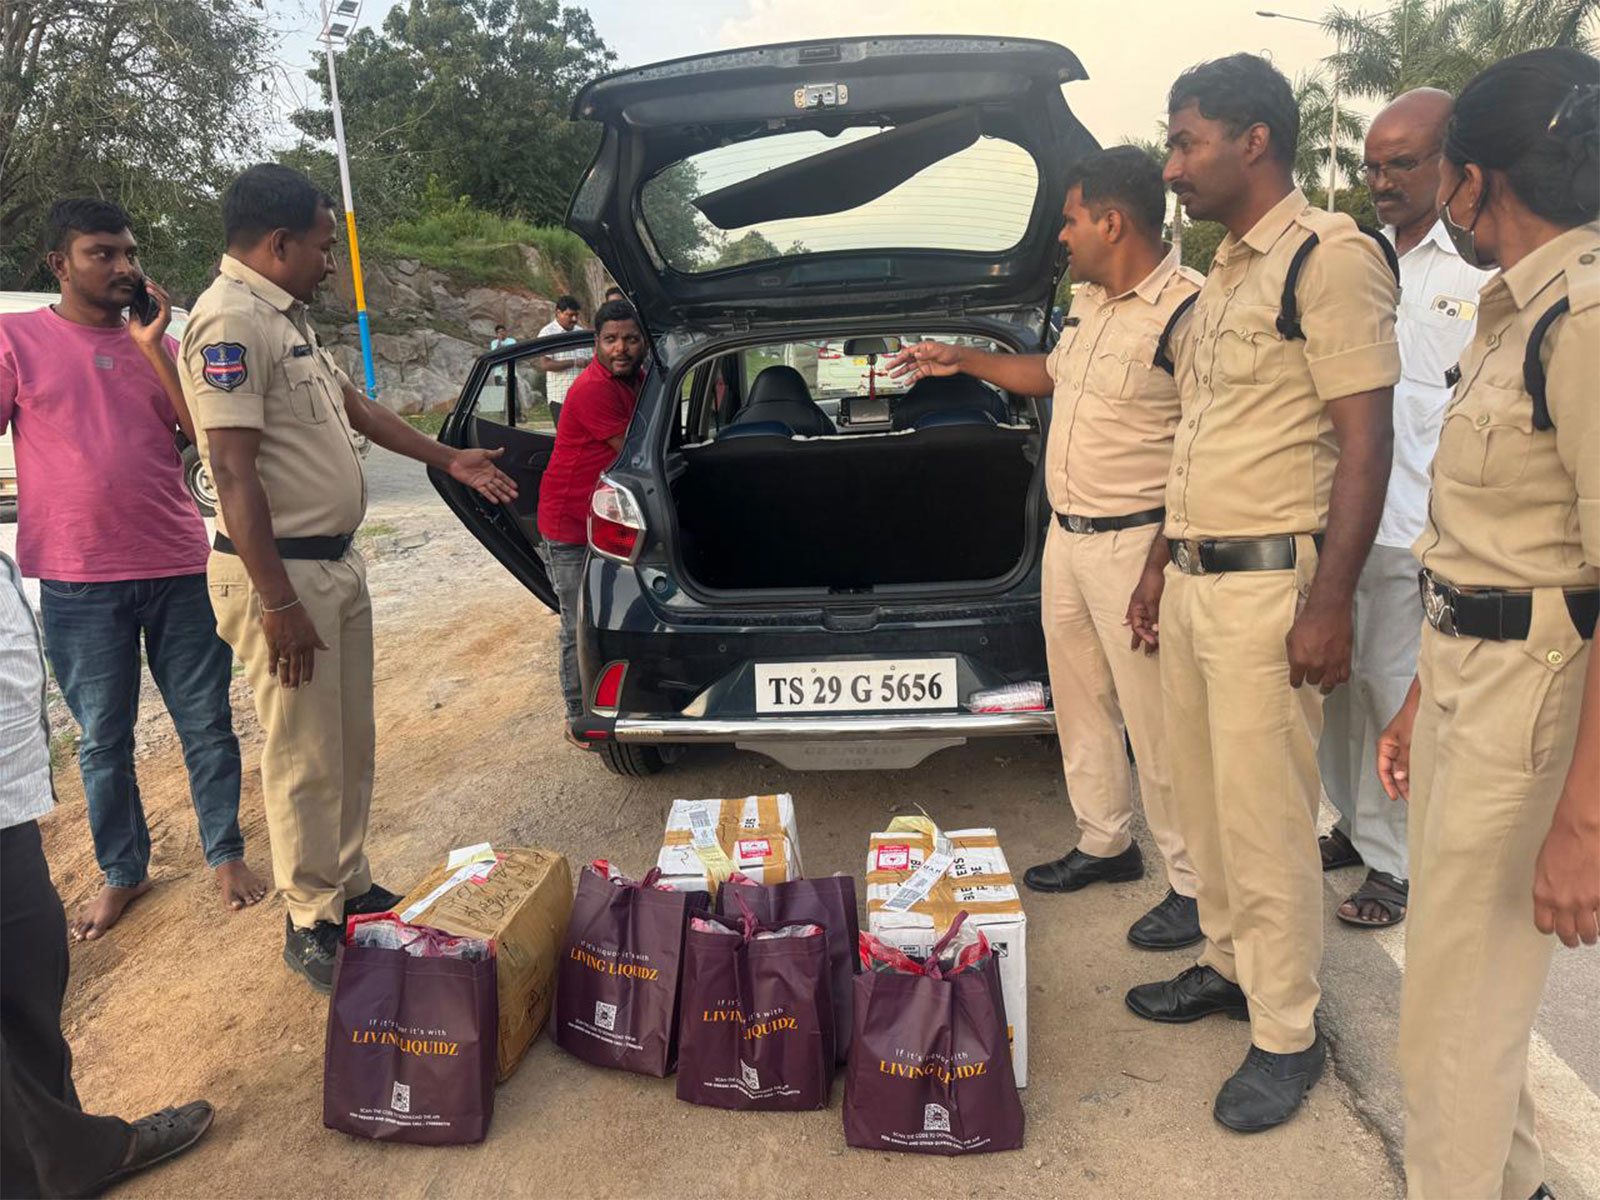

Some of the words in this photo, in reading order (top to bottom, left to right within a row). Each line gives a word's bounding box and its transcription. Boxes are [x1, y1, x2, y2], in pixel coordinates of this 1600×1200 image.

[768, 677, 805, 705] TS
[813, 675, 842, 704] 29
[851, 674, 872, 703] G
[881, 672, 942, 702] 5656
[570, 947, 606, 973] LIVING
[608, 962, 659, 981] LIQUIDZ
[763, 1007, 784, 1018] with
[410, 1027, 424, 1035] it's
[428, 1029, 447, 1037] with
[703, 1010, 744, 1024] LIVIN
[744, 1018, 799, 1041] IQUIDZ
[895, 1047, 904, 1057] If
[906, 1051, 922, 1062] it's
[880, 1060, 935, 1079] LIVING
